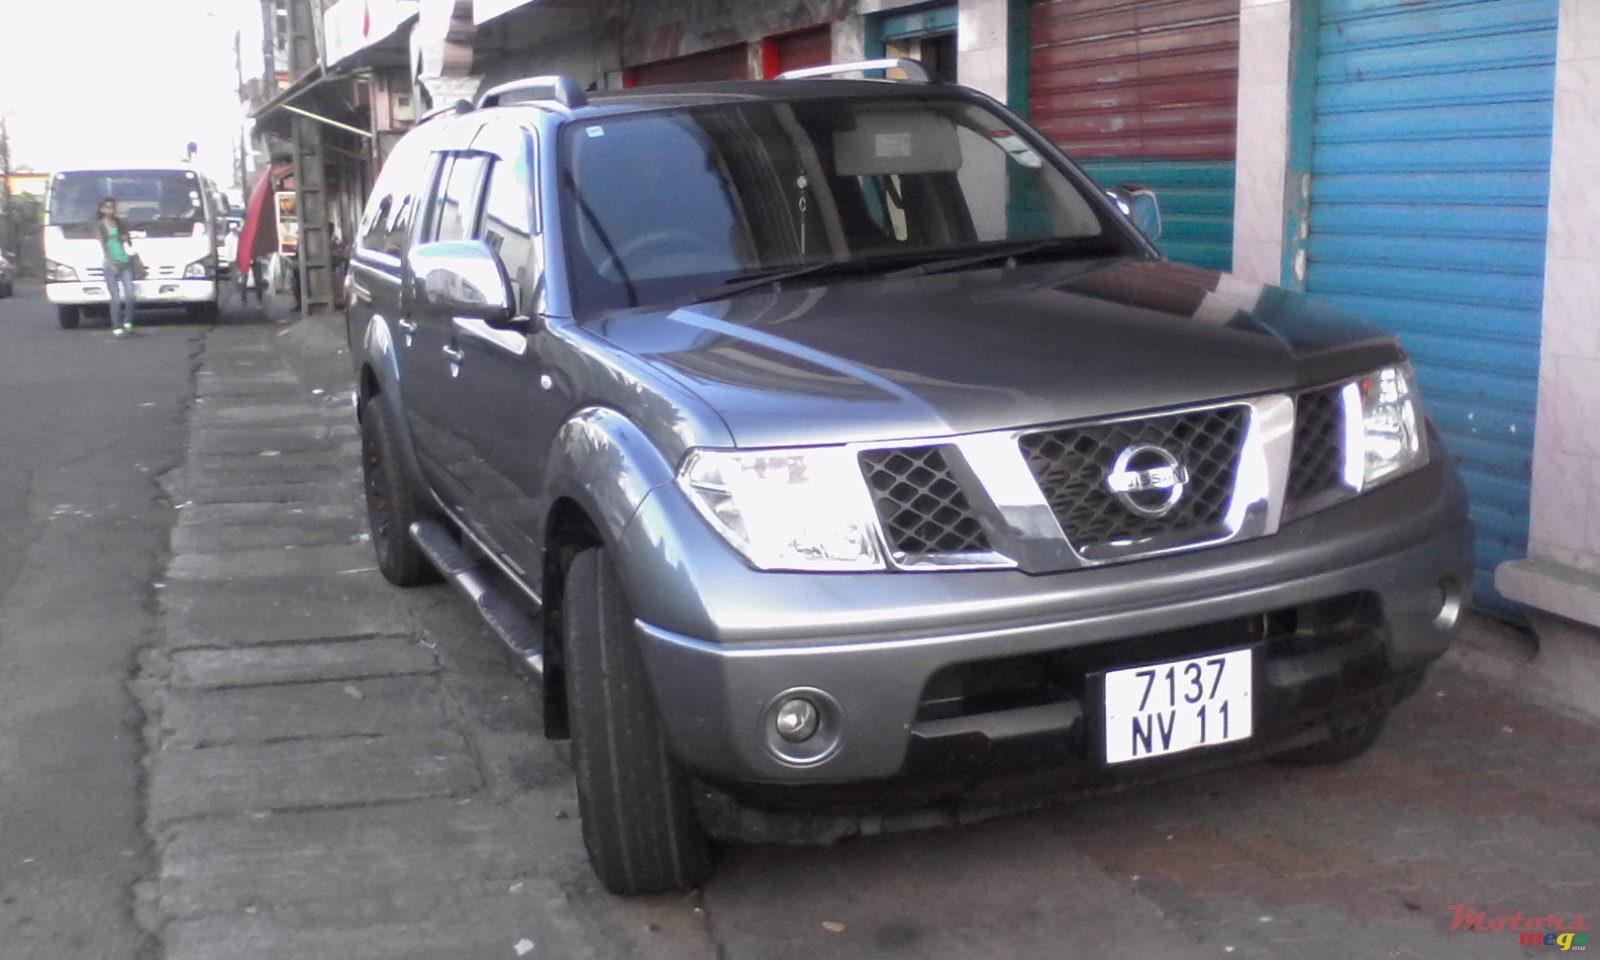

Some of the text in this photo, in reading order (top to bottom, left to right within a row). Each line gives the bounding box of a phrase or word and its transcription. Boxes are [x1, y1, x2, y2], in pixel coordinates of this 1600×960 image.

[1135, 658, 1226, 712] 7137
[1132, 700, 1229, 757] NV 11
